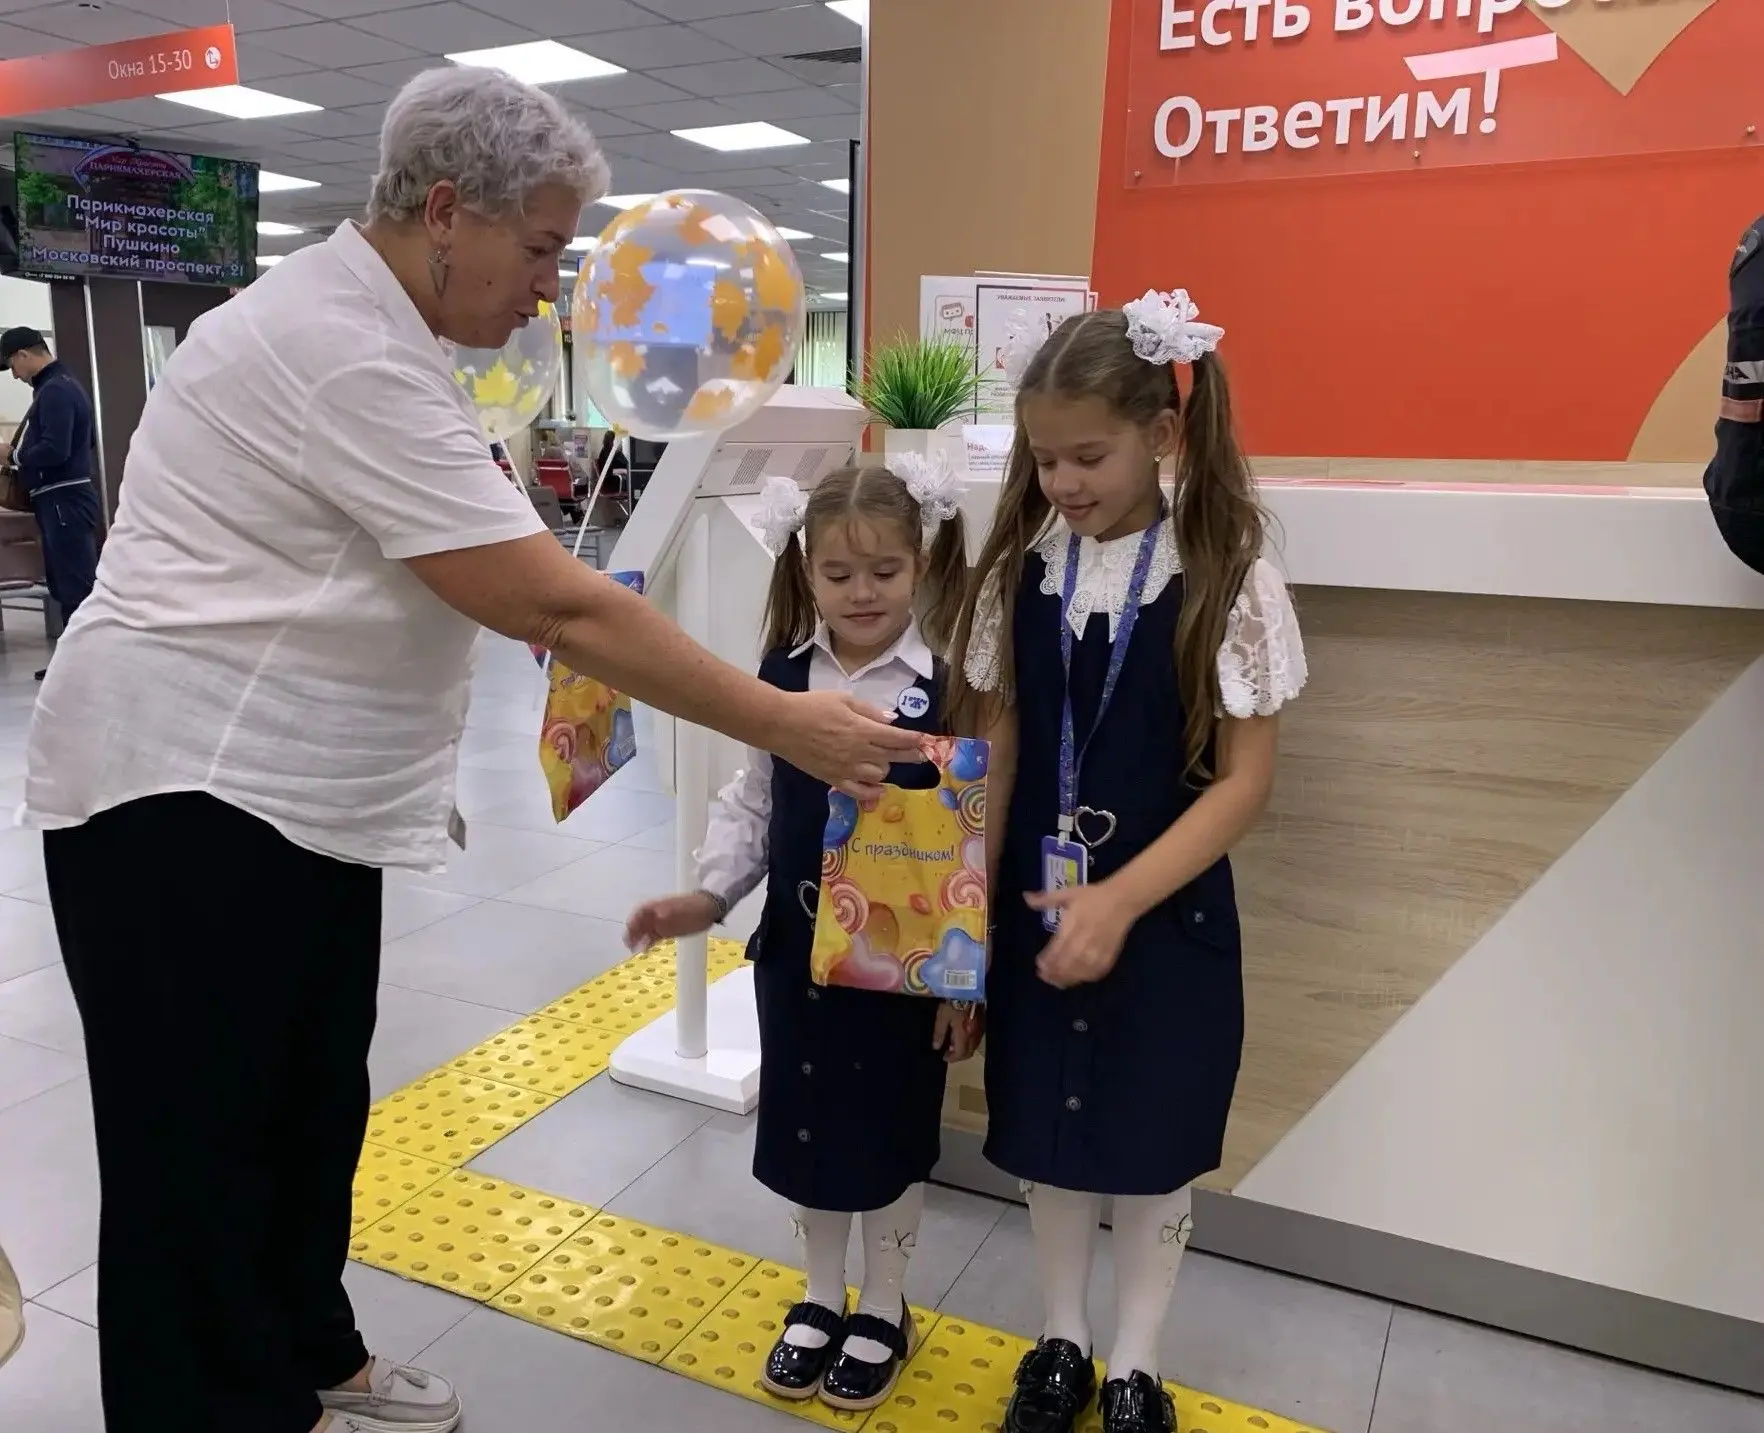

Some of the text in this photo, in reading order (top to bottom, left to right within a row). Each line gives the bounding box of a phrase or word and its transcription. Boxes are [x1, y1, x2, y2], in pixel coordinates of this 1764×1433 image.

[1160, 0, 1311, 50] Есть
[108, 49, 192, 80] Окна 15-30
[1153, 67, 1501, 158] Ответим!
[67, 194, 214, 223] Парикмахерская
[103, 234, 180, 254] Пушкино
[32, 247, 140, 268] Московский
[145, 258, 225, 277] проспект,
[851, 837, 955, 863] С праздником!
